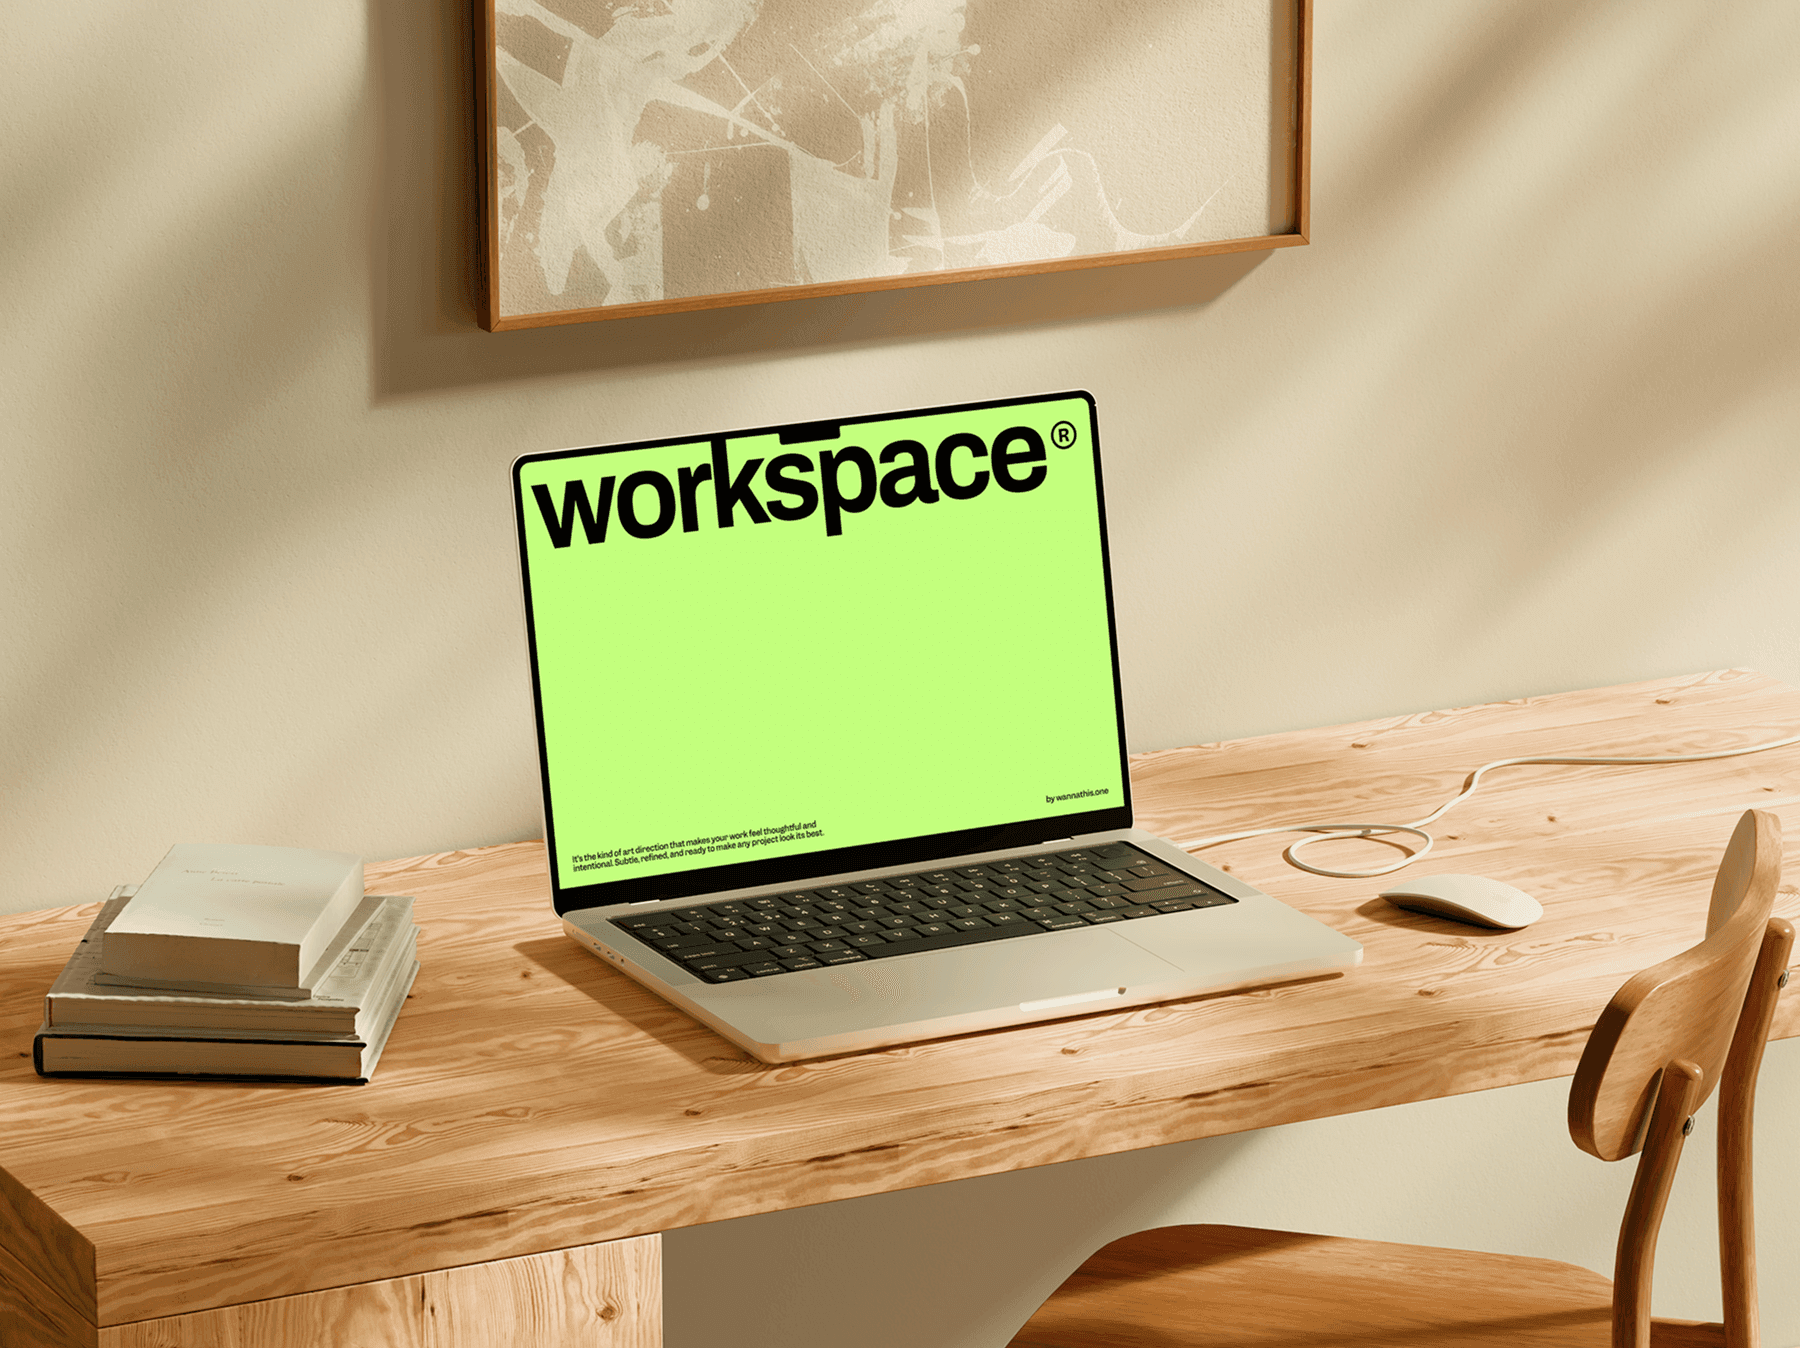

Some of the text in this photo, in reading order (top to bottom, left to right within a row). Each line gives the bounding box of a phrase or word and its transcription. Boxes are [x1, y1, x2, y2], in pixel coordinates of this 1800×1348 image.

[1046, 788, 1109, 804] by wannathis.one
[572, 820, 817, 863] It's the kind of art direction that makes your work feel thoughtful and
[614, 856, 640, 867] Subtle,
[641, 852, 669, 862] refined,
[670, 849, 684, 858] and
[685, 846, 706, 856] ready
[716, 842, 736, 851] make
[737, 840, 751, 849] any
[752, 835, 778, 847] project
[779, 833, 795, 842] look
[796, 831, 805, 840] its
[806, 829, 825, 838] best.
